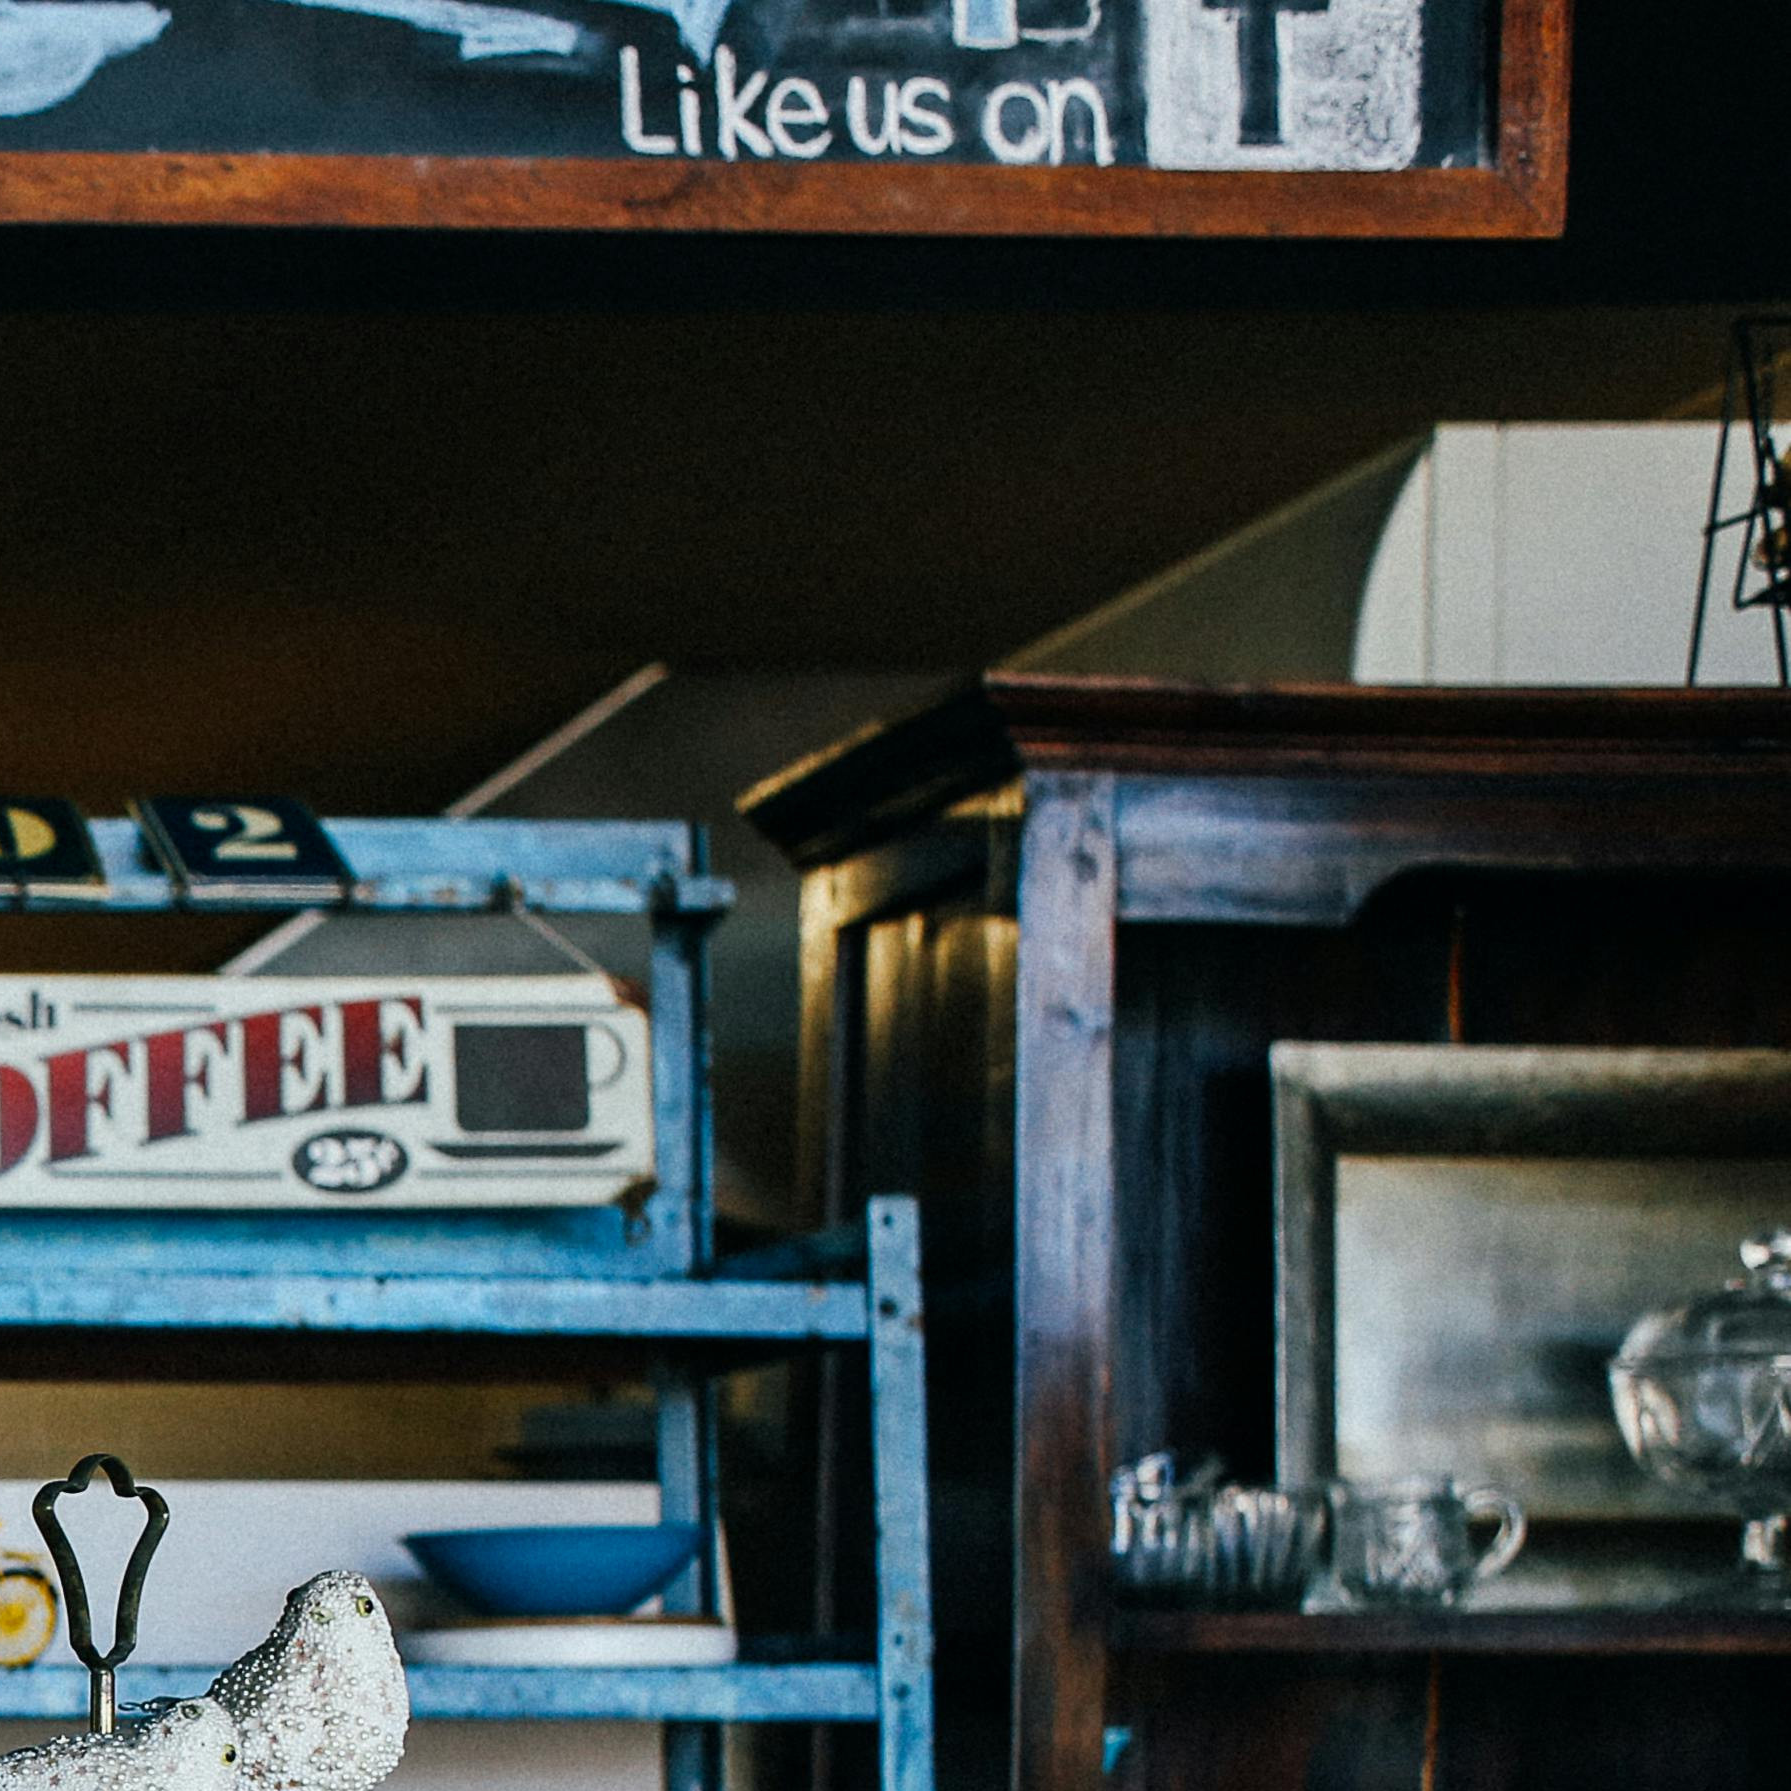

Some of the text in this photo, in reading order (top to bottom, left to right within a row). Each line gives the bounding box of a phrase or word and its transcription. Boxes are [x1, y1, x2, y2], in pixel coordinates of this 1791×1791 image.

[618, 43, 1116, 168] Like us on
[188, 804, 299, 861] 2
